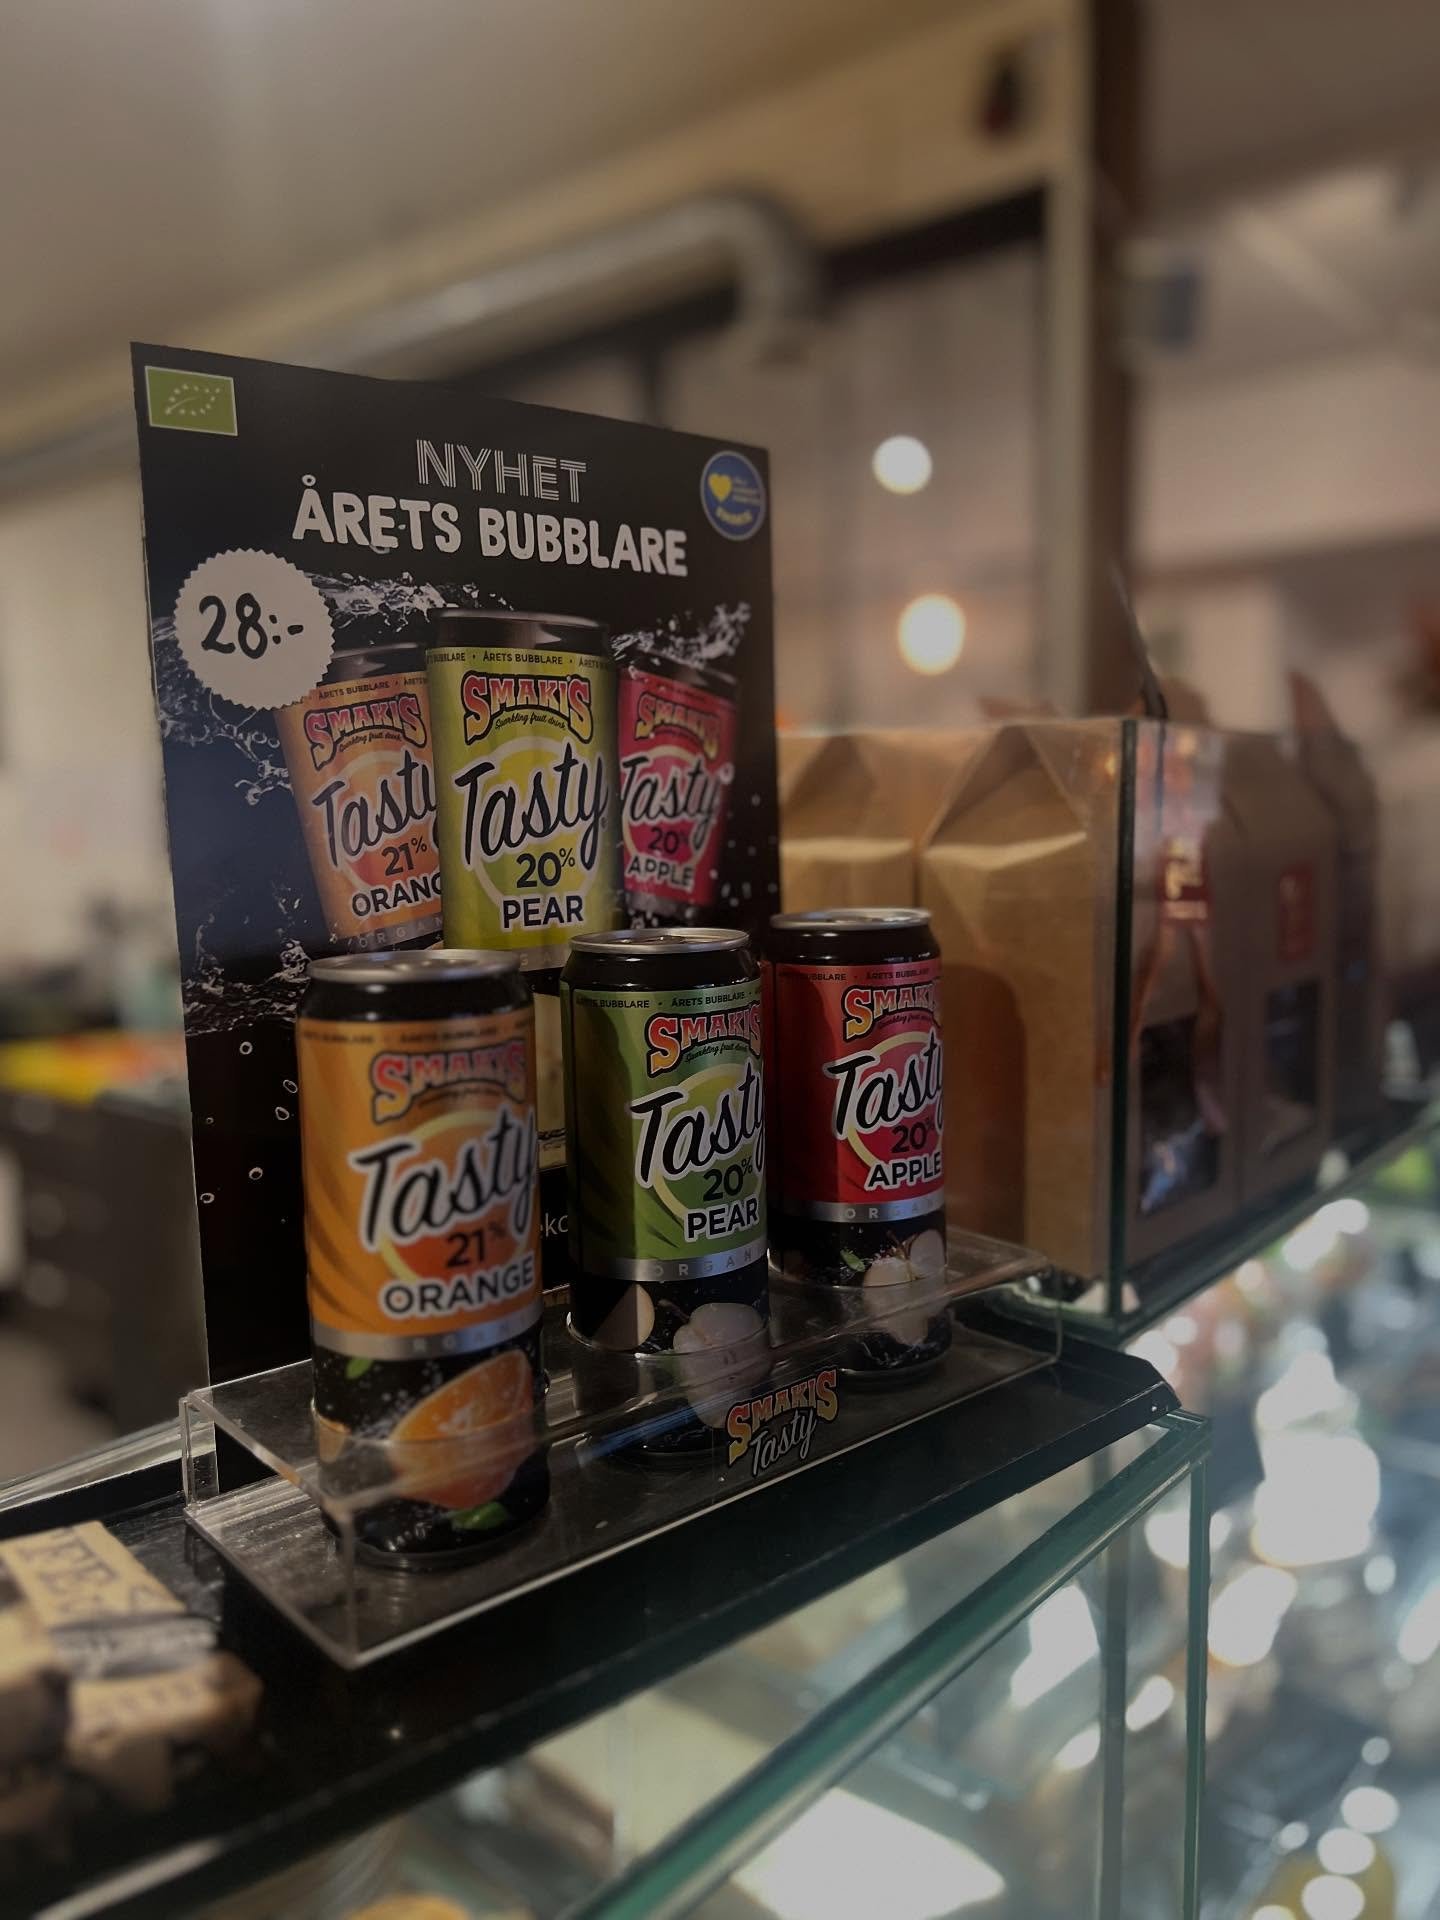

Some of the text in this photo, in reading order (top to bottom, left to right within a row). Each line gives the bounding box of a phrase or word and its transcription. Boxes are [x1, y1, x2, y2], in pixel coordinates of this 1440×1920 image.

[415, 439, 588, 504] NYHET
[291, 473, 689, 578] ÅRETS BUBBLARE
[198, 591, 304, 659] 28:-
[482, 650, 513, 662] ÅRETS
[515, 652, 563, 665] BUBBLARE
[303, 692, 428, 770] SMAKIS
[455, 742, 609, 871] Tasty
[622, 756, 721, 851] Tasty
[381, 835, 428, 877] 21%
[516, 848, 576, 889] 20%
[628, 855, 694, 888] APPLE
[502, 894, 584, 929] PEAR
[355, 1106, 536, 1245] Tasty
[702, 1155, 753, 1202] 20%
[867, 1151, 942, 1188] APPLE
[687, 1197, 758, 1239] PEAR
[385, 1254, 534, 1314] ORANGE
[725, 1367, 839, 1469] SMAKIS
[748, 1408, 818, 1478] Tasty
